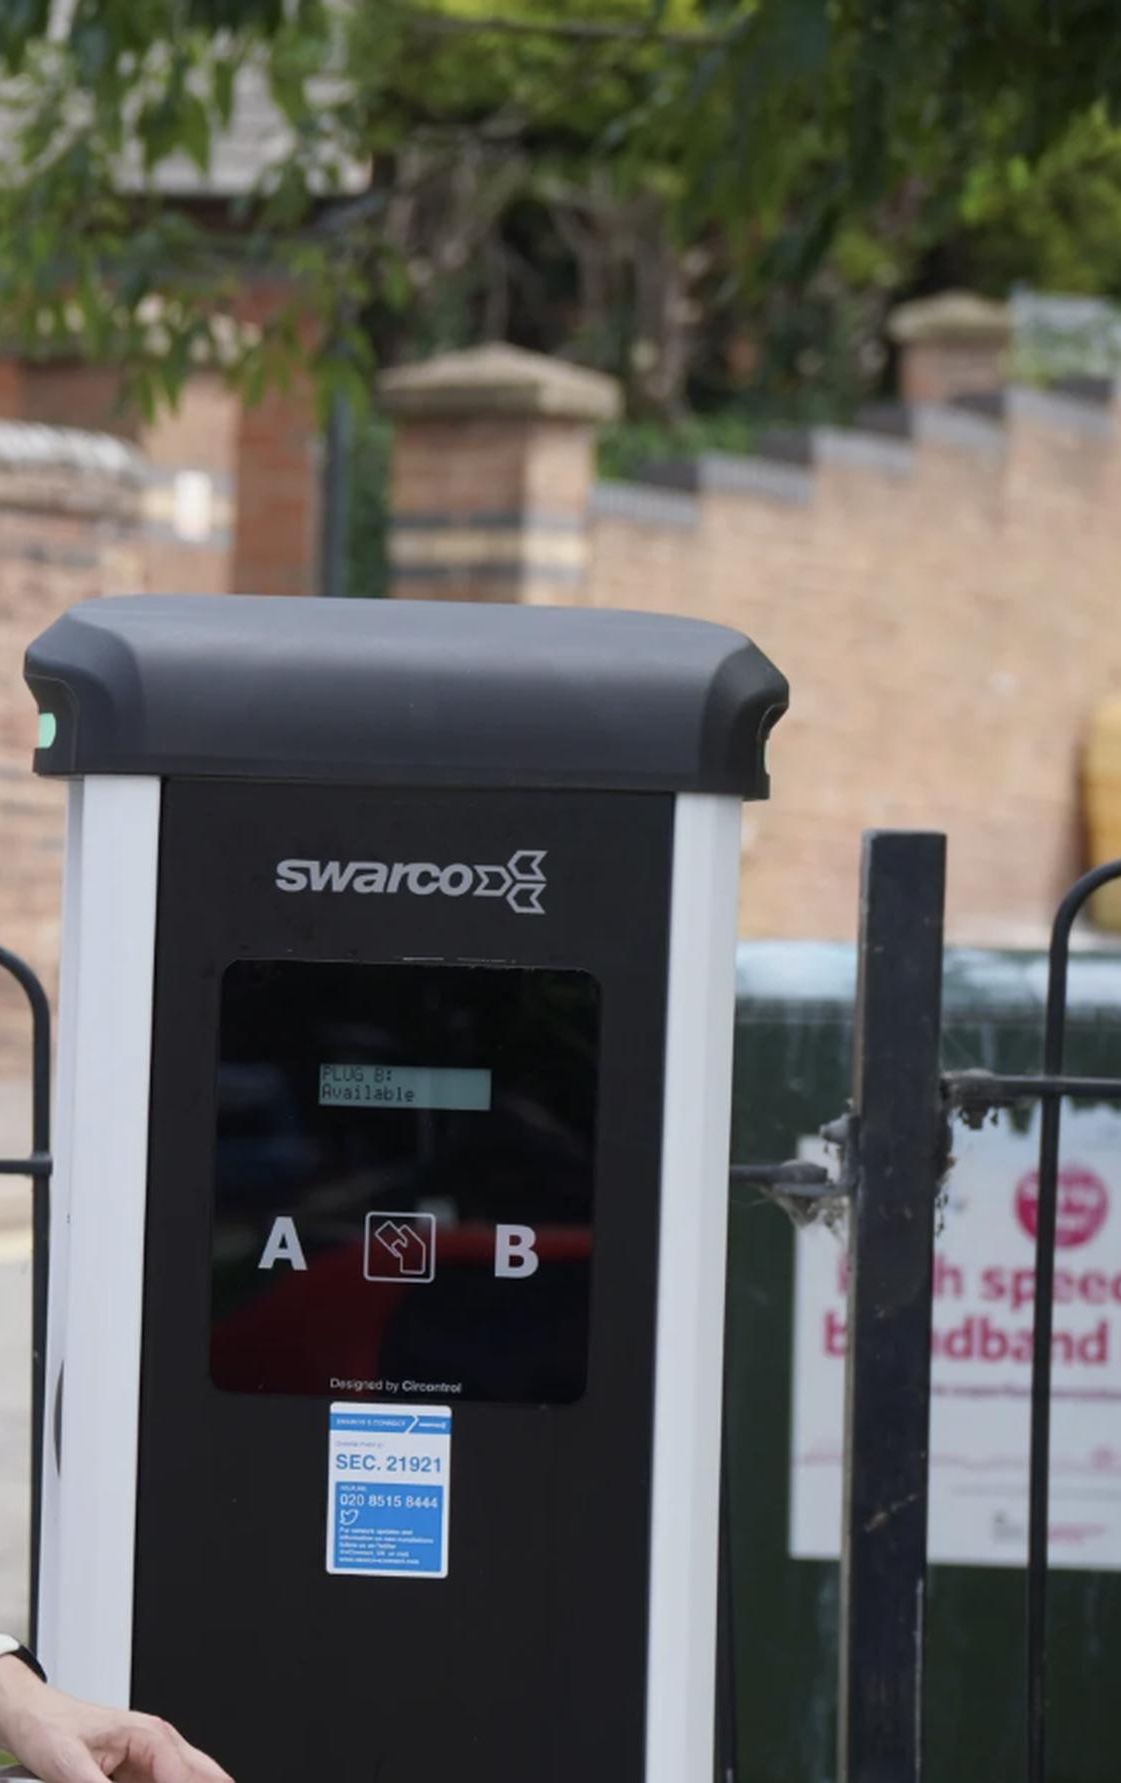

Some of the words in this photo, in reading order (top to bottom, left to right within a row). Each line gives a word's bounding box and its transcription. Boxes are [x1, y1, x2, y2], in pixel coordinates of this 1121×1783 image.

[275, 858, 474, 896] swarco
[322, 1067, 364, 1082] PLUG
[322, 1083, 415, 1102] Available
[258, 1216, 307, 1270] A
[494, 1224, 539, 1279] B
[823, 1309, 1109, 1367] bdband
[330, 1378, 383, 1392] Designed
[385, 1380, 399, 1393] by
[402, 1380, 463, 1393] Circontrol
[336, 1454, 381, 1470] SEC.
[386, 1456, 441, 1472] 21921
[340, 1494, 365, 1506] 020
[368, 1495, 402, 1508] 8515
[405, 1496, 438, 1509] 8444
